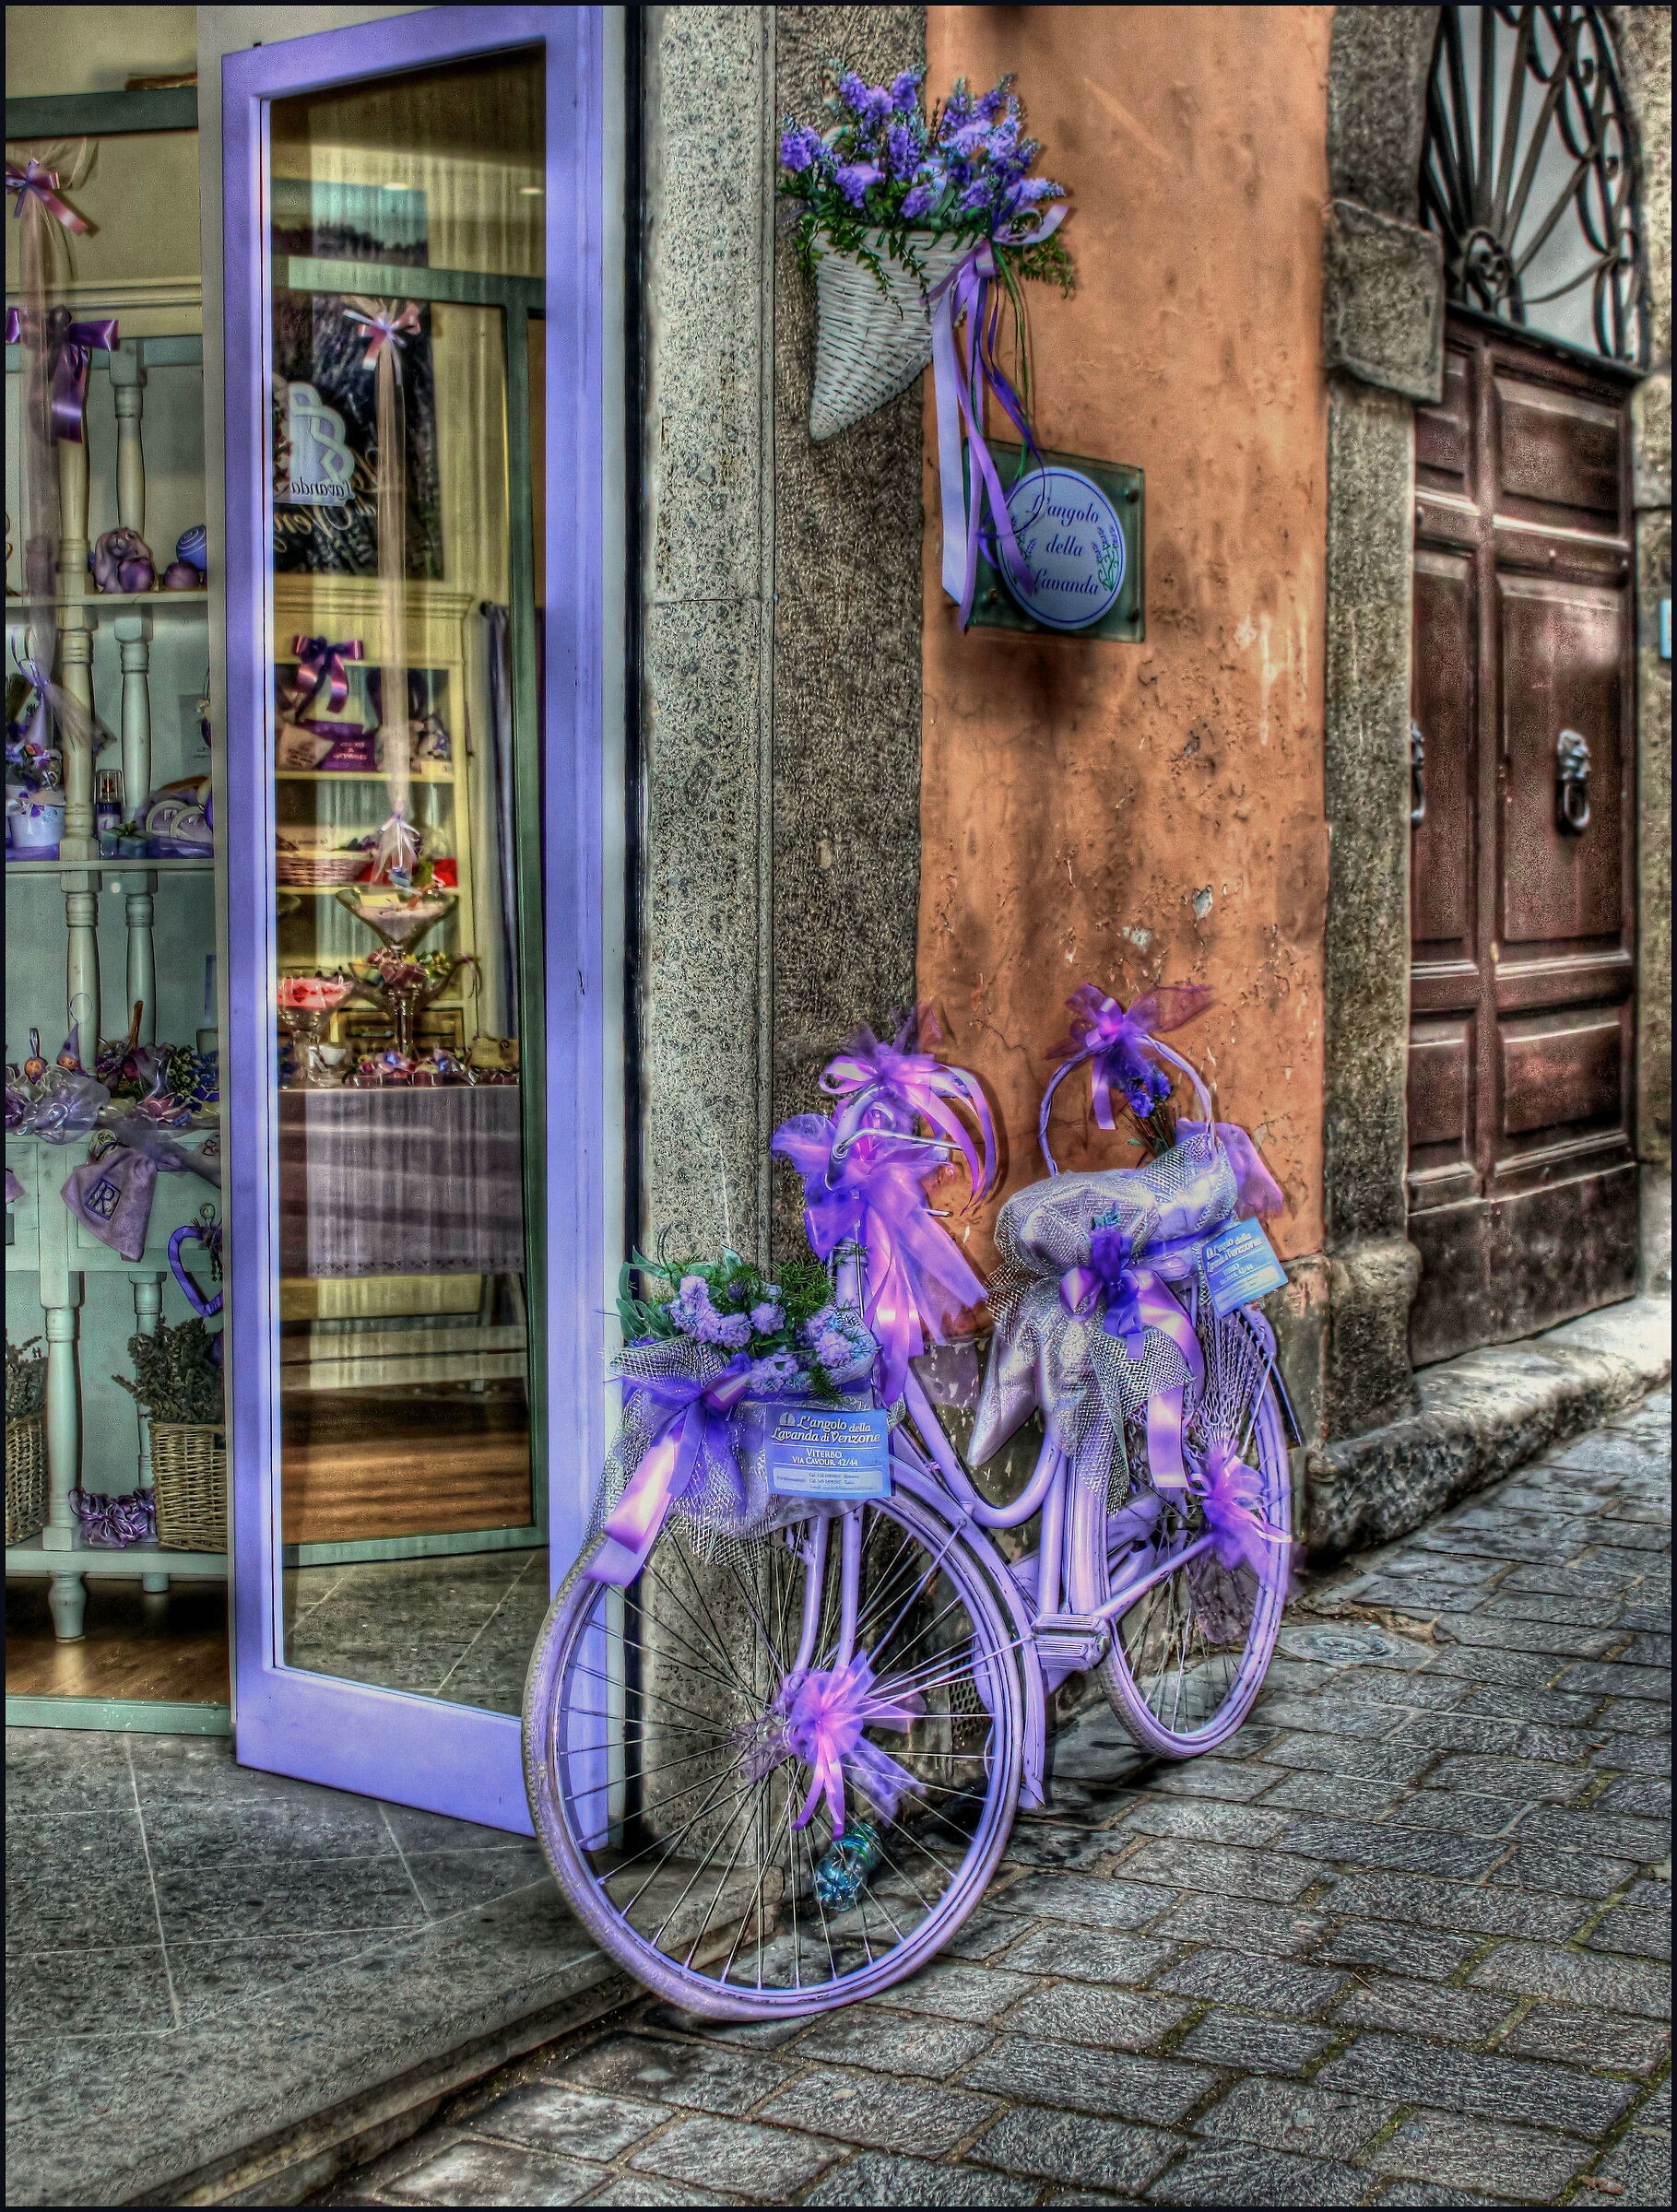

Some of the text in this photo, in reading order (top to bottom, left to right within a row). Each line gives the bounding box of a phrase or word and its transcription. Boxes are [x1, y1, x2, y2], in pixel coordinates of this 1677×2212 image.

[1026, 494, 1099, 527] L'angolo
[1045, 534, 1084, 557] della
[1033, 568, 1099, 595] Lavanda
[797, 1416, 872, 1433] L'angolo della
[771, 1427, 880, 1444] Lavanda di Venzone
[806, 1448, 843, 1459] VITERBO
